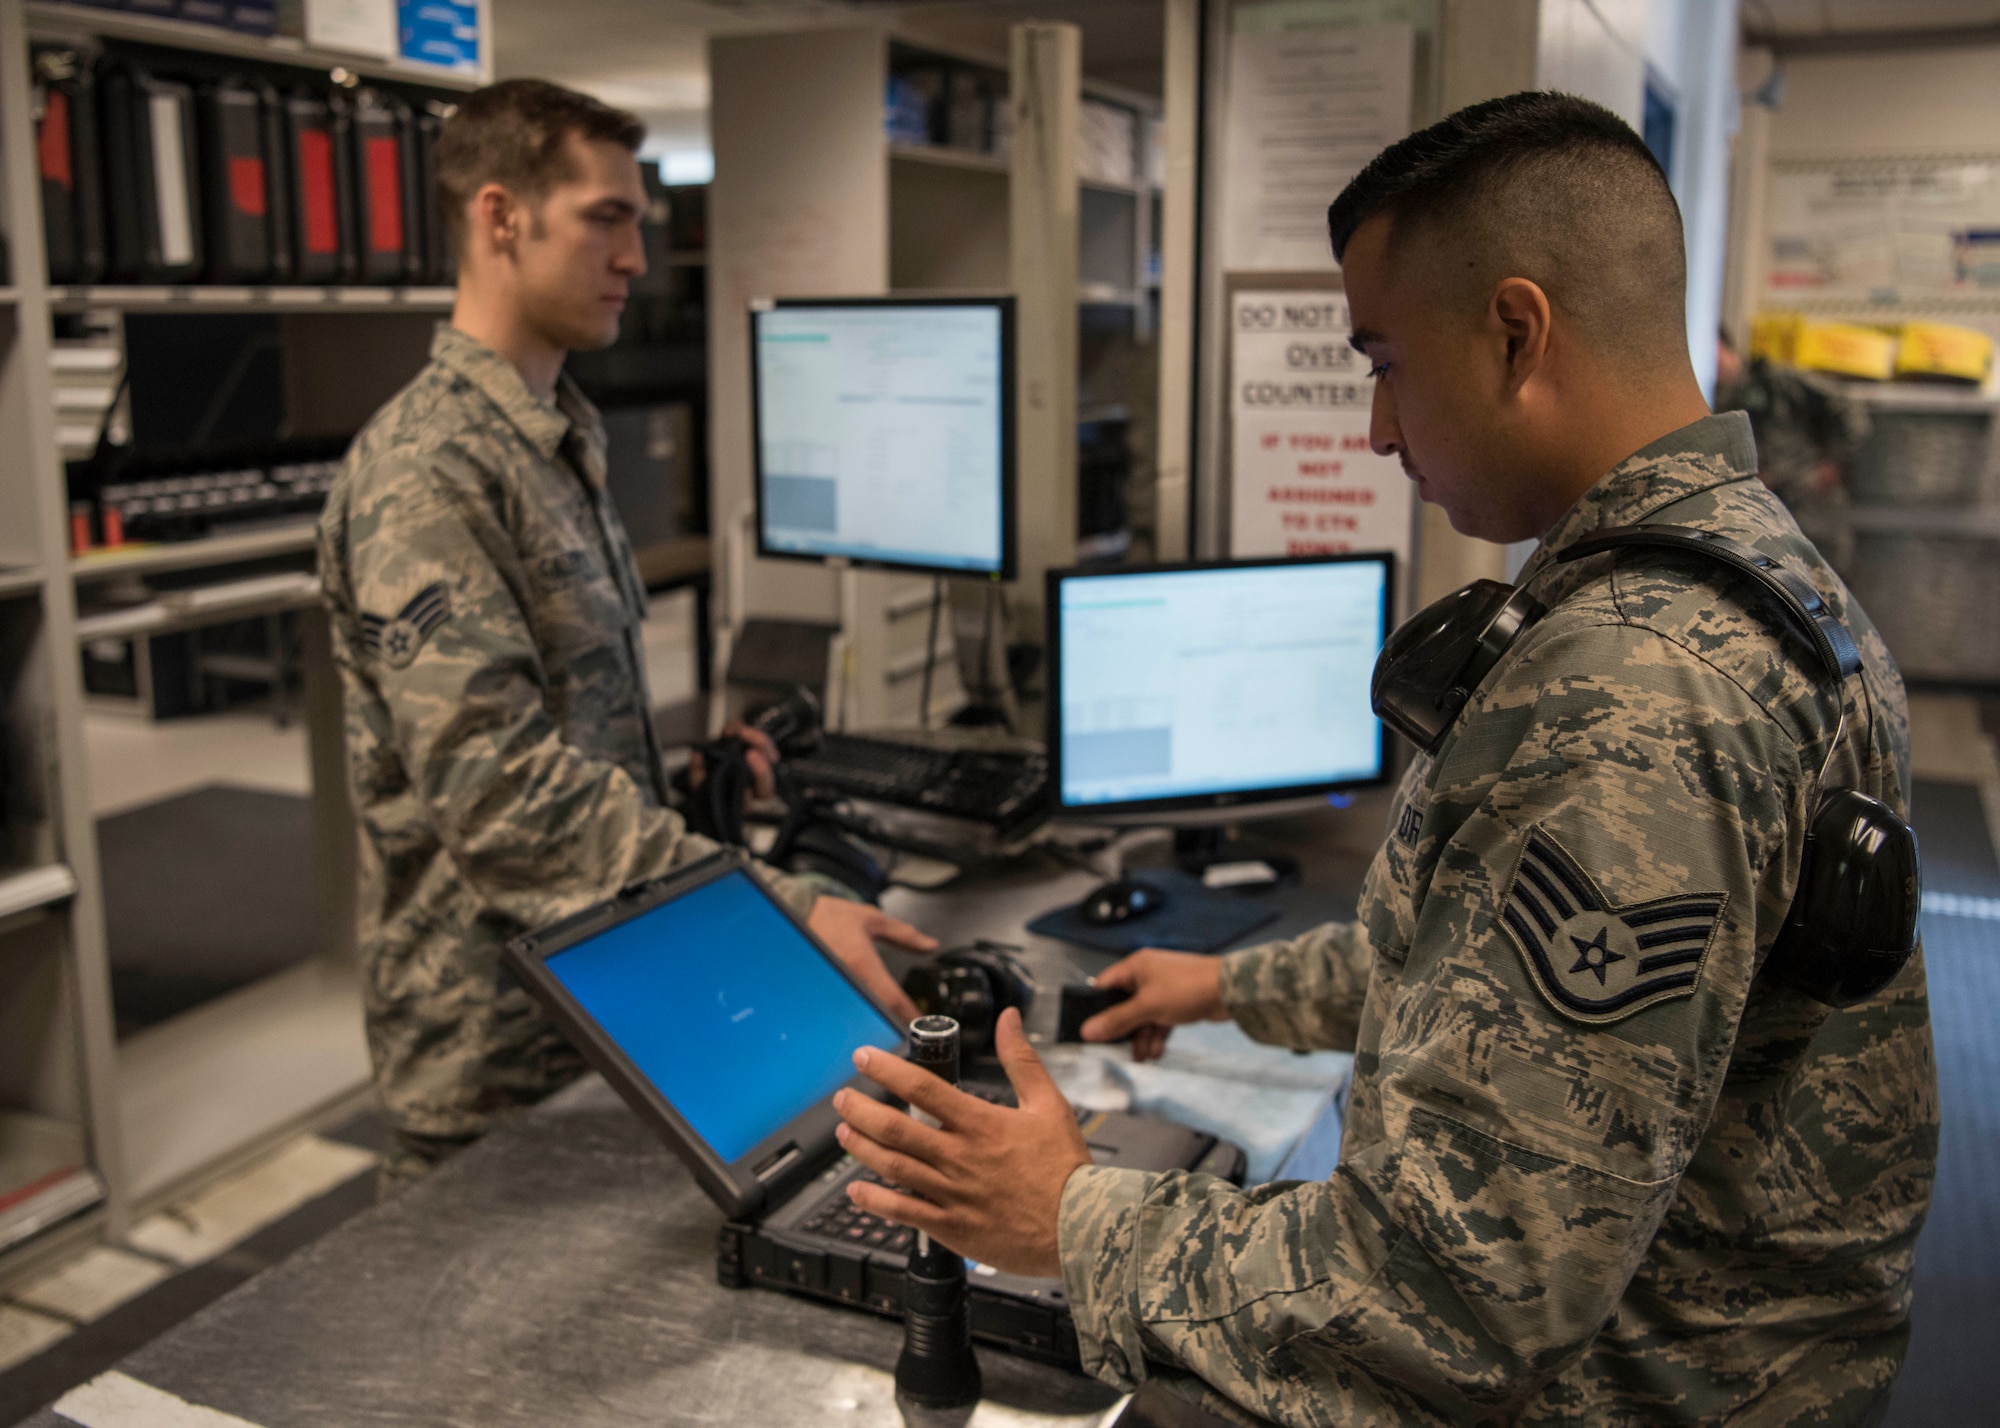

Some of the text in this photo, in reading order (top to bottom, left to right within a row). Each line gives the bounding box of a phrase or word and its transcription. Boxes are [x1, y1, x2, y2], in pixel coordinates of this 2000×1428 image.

[1239, 305, 1275, 328] DO
[1284, 305, 1333, 328] NOT
[1286, 345, 1350, 367] OVER
[1290, 433, 1332, 451] YOU
[1341, 433, 1371, 451] AR
[1298, 459, 1342, 477] NOT
[1267, 487, 1376, 505] ASSIGNED
